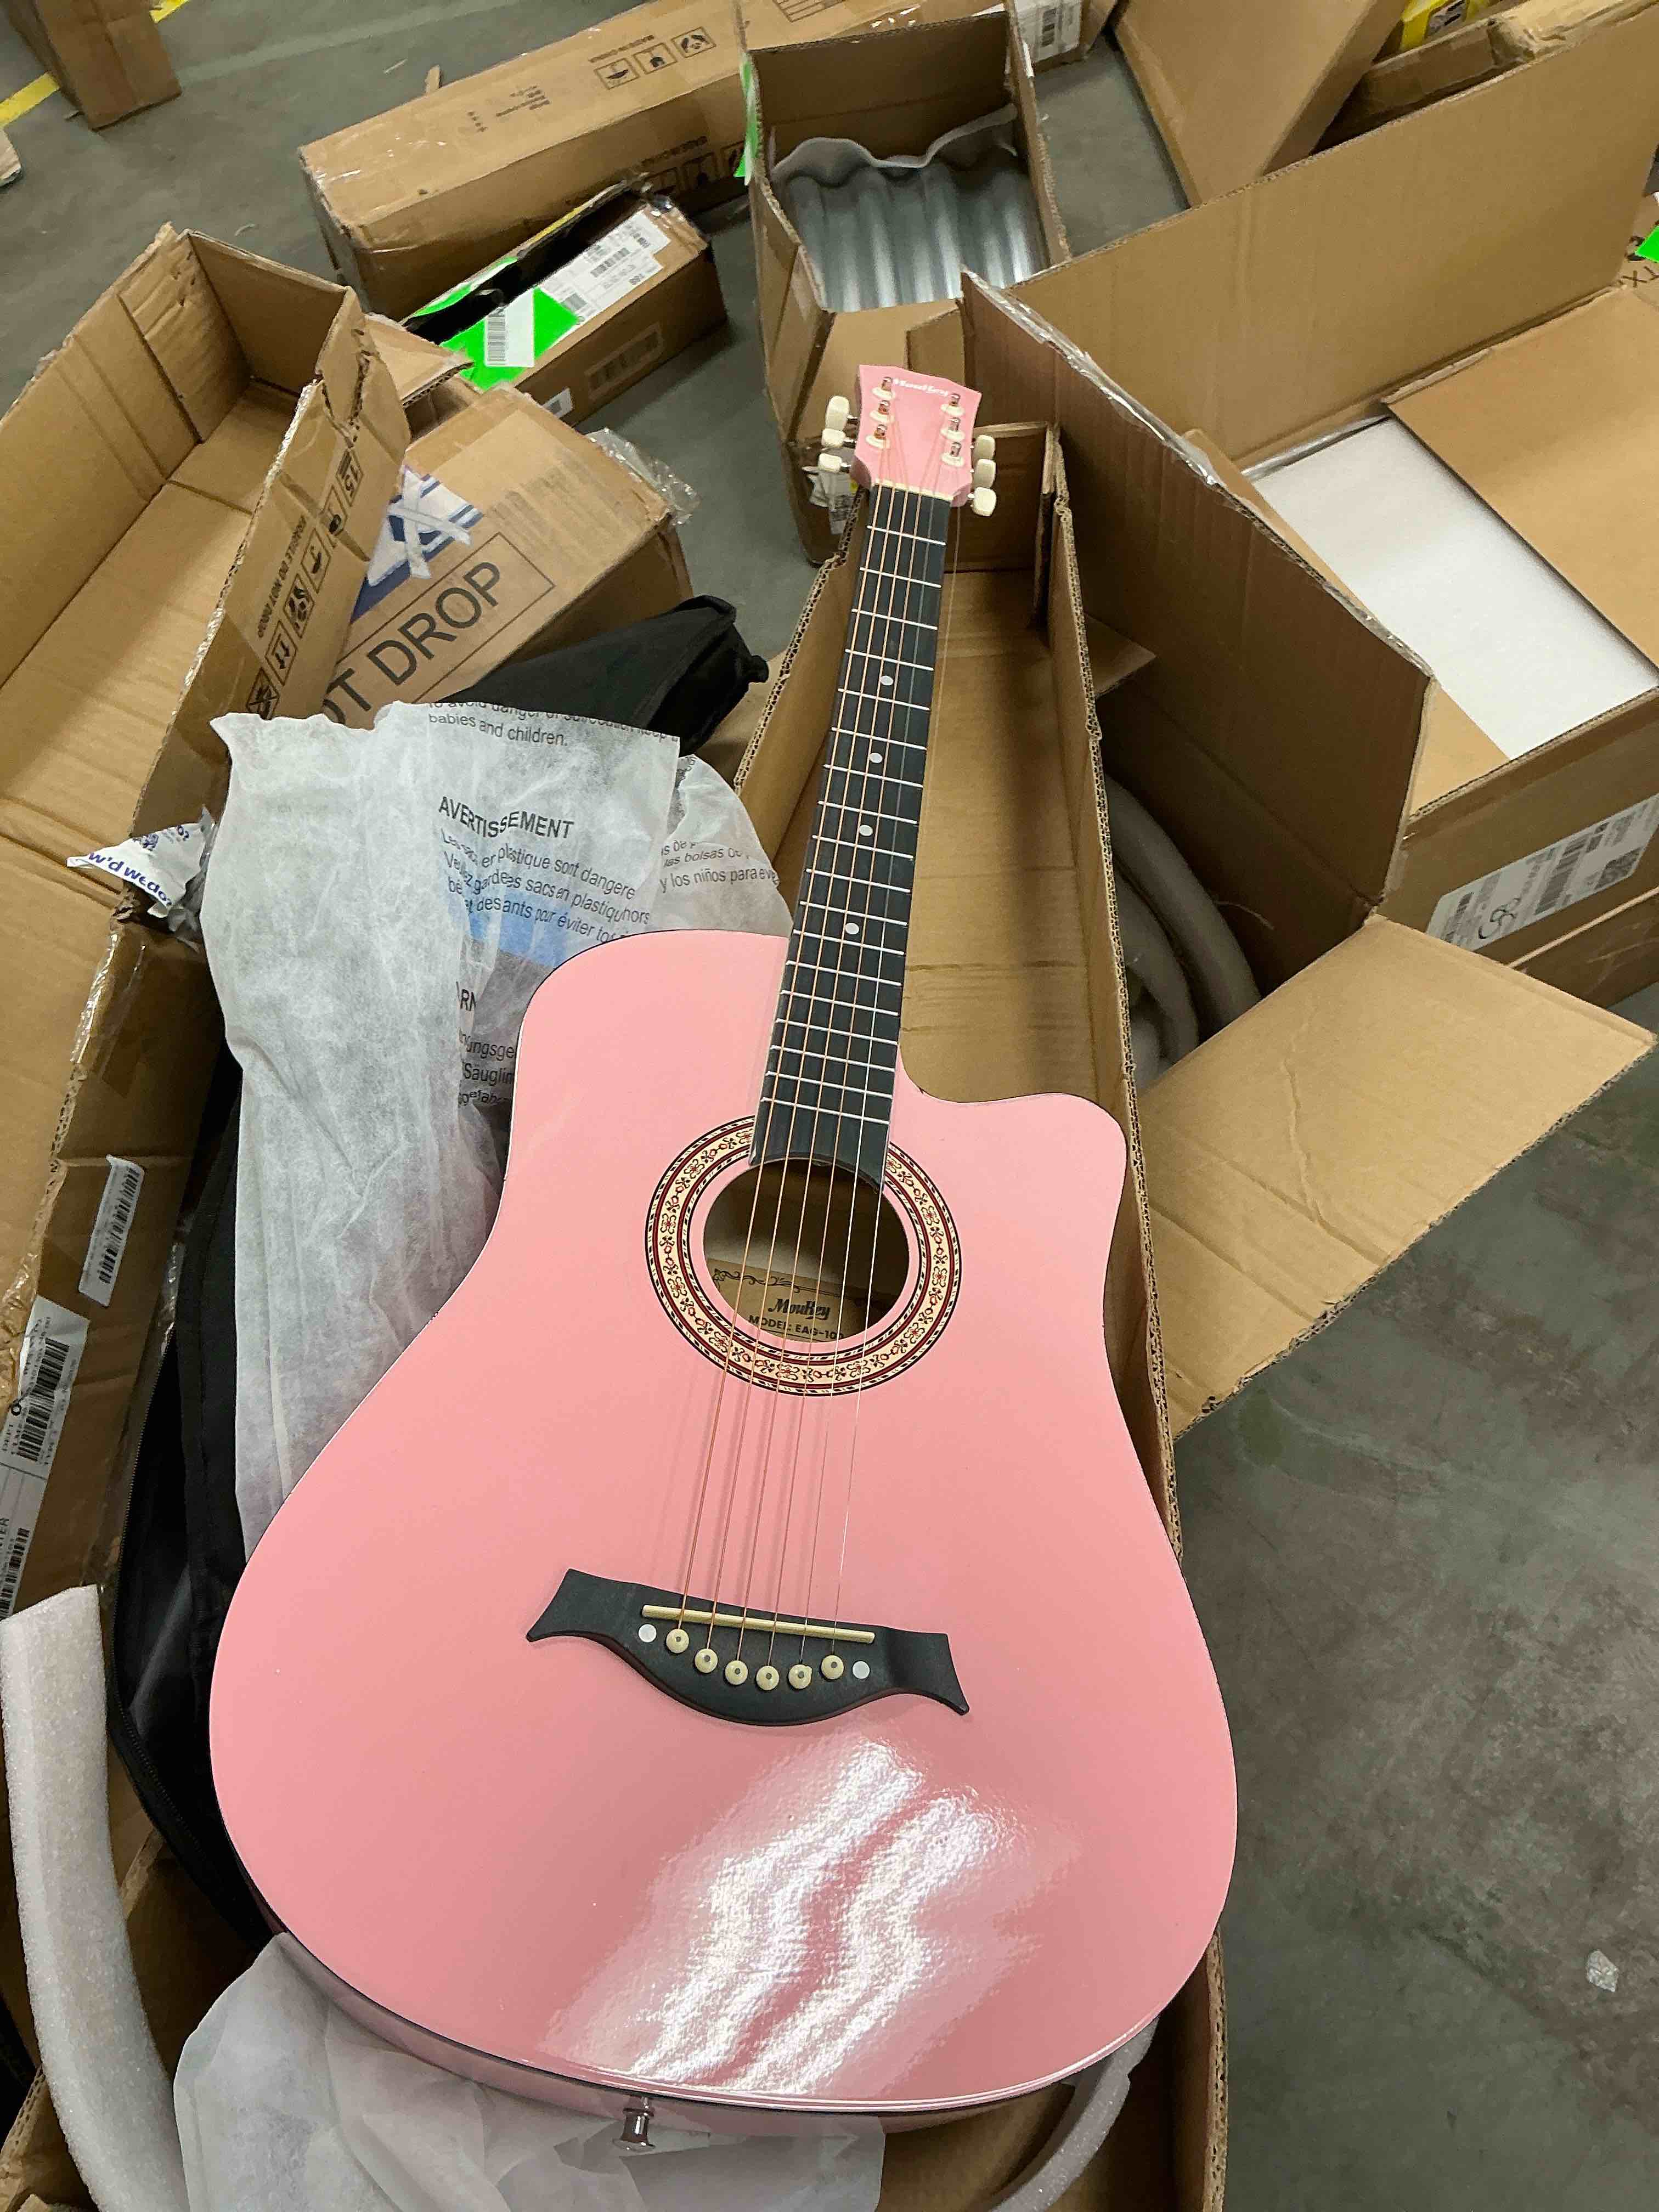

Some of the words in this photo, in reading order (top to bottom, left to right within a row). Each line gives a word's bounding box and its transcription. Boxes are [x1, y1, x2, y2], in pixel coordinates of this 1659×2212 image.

[367, 562, 500, 685] DROP
[429, 714, 476, 727] babies
[478, 718, 503, 738] and
[507, 727, 568, 747] children.
[438, 796, 574, 839] AVERTISSEMENT
[659, 878, 668, 893] y
[670, 873, 691, 887] los
[693, 868, 726, 883] niños
